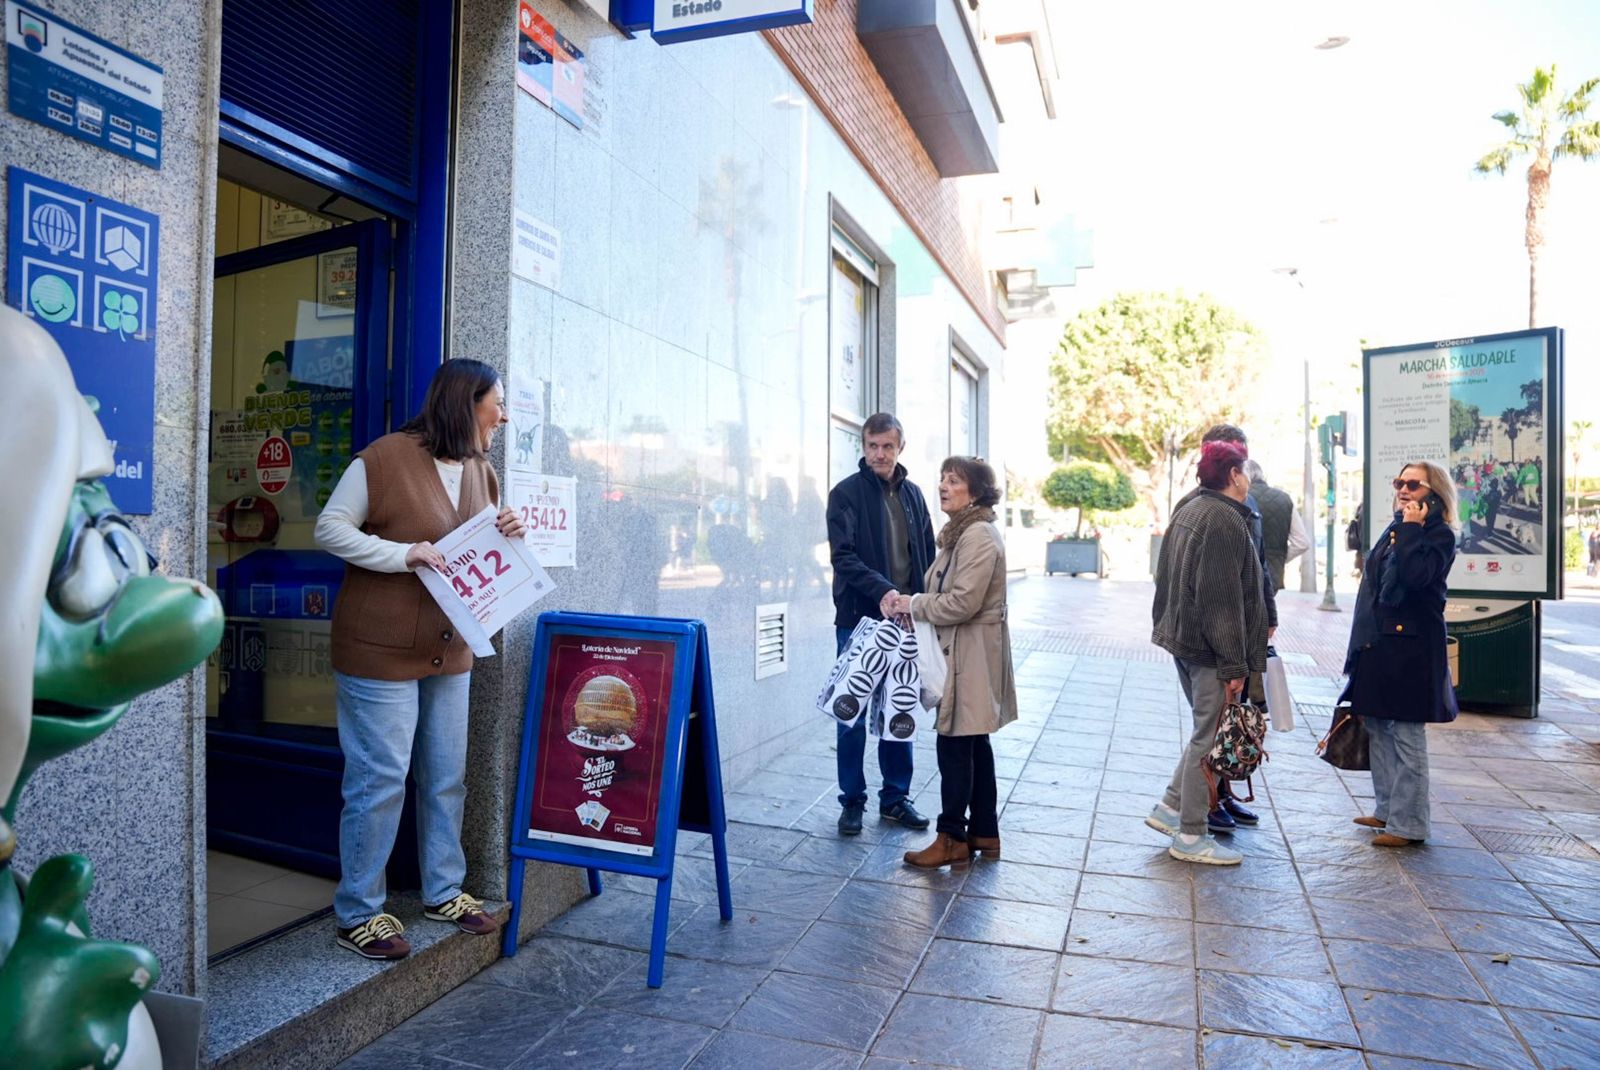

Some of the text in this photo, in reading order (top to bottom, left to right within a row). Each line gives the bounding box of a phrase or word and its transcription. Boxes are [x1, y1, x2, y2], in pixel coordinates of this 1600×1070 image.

[672, 0, 722, 18] Estado
[62, 48, 106, 74] Apuestas
[108, 69, 122, 81] del
[123, 75, 152, 95] Estado
[102, 57, 108, 66] y
[1434, 338, 1475, 348] JCDecaux
[1399, 349, 1517, 374] MARCHA SALUDABLE
[245, 390, 311, 413] DUENDE
[244, 407, 313, 432] VERDE
[1395, 417, 1426, 425] MASCOTA
[263, 442, 284, 462] +18
[115, 461, 143, 480] del
[521, 505, 568, 531] 25412
[581, 757, 615, 777] SORTEO
[582, 775, 613, 791] NOS UNE
